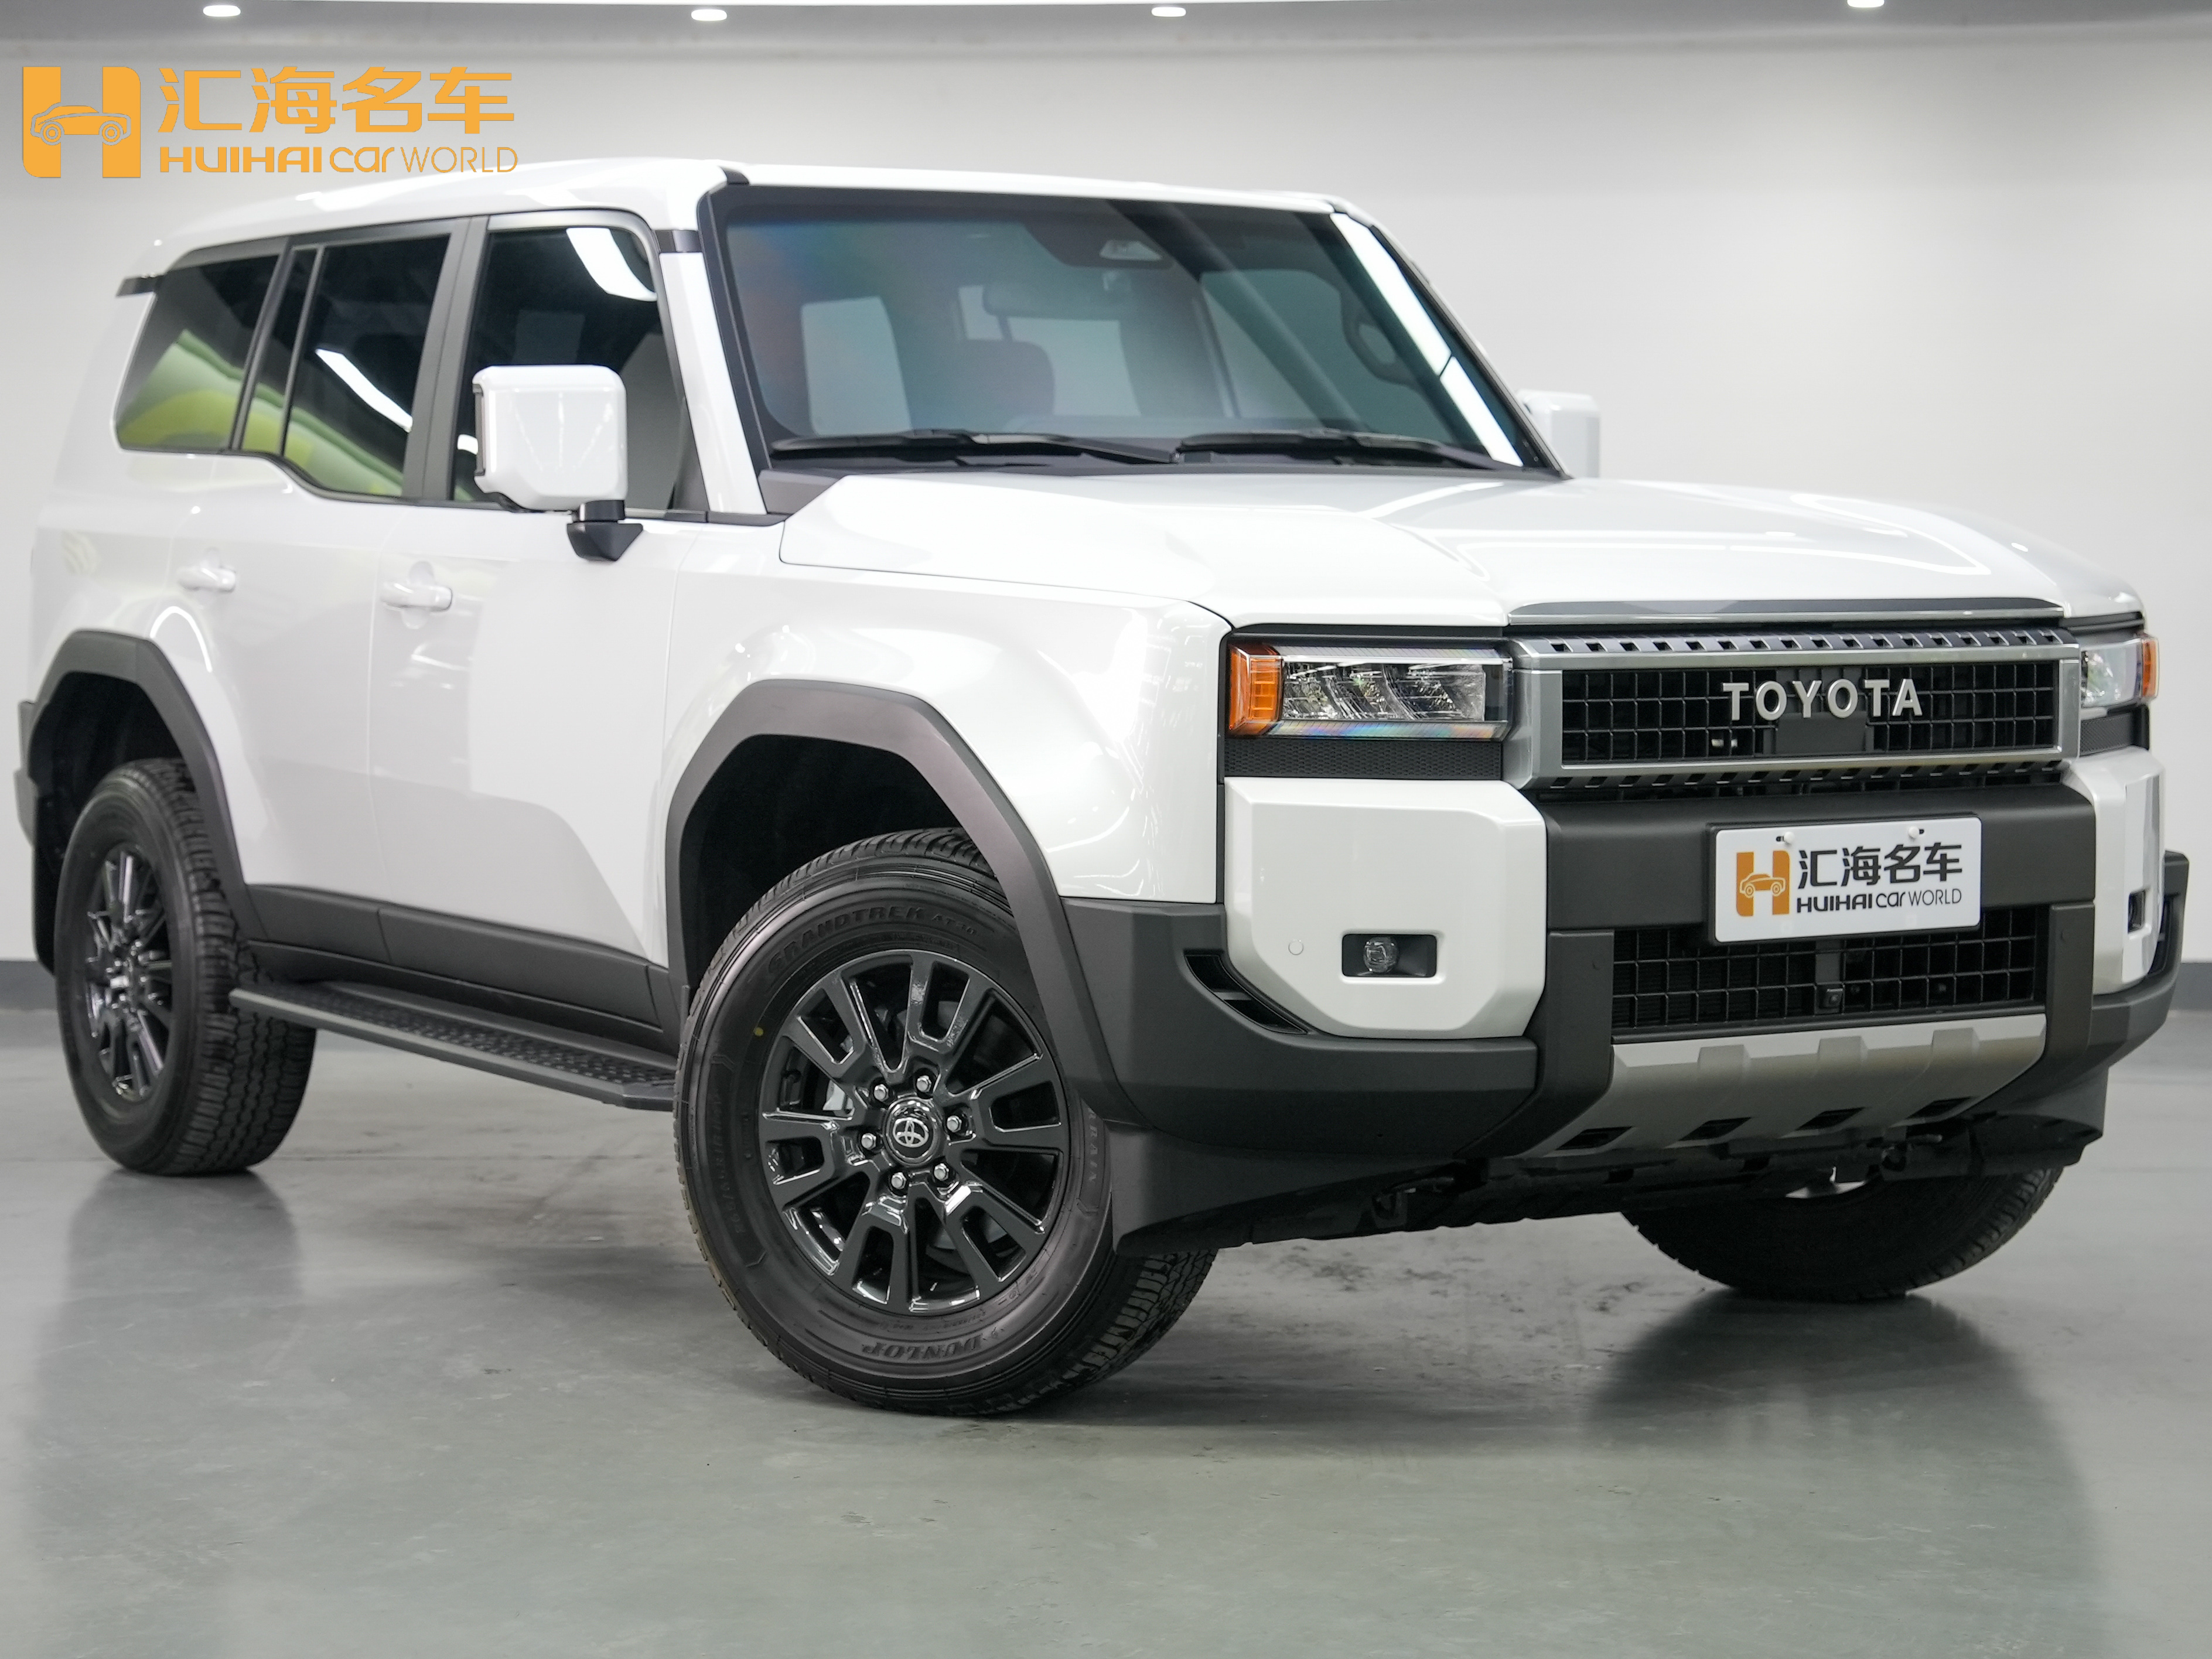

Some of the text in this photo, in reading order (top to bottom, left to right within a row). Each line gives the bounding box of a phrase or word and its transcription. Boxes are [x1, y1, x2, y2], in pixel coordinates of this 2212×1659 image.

[1722, 678, 1923, 721] TOYOTA
[1798, 842, 1963, 890] 汇海名车
[1796, 888, 1962, 913] HUIHAI car WORLD
[767, 906, 927, 975] GRANDTREK
[861, 1333, 984, 1360] DUNLOP
